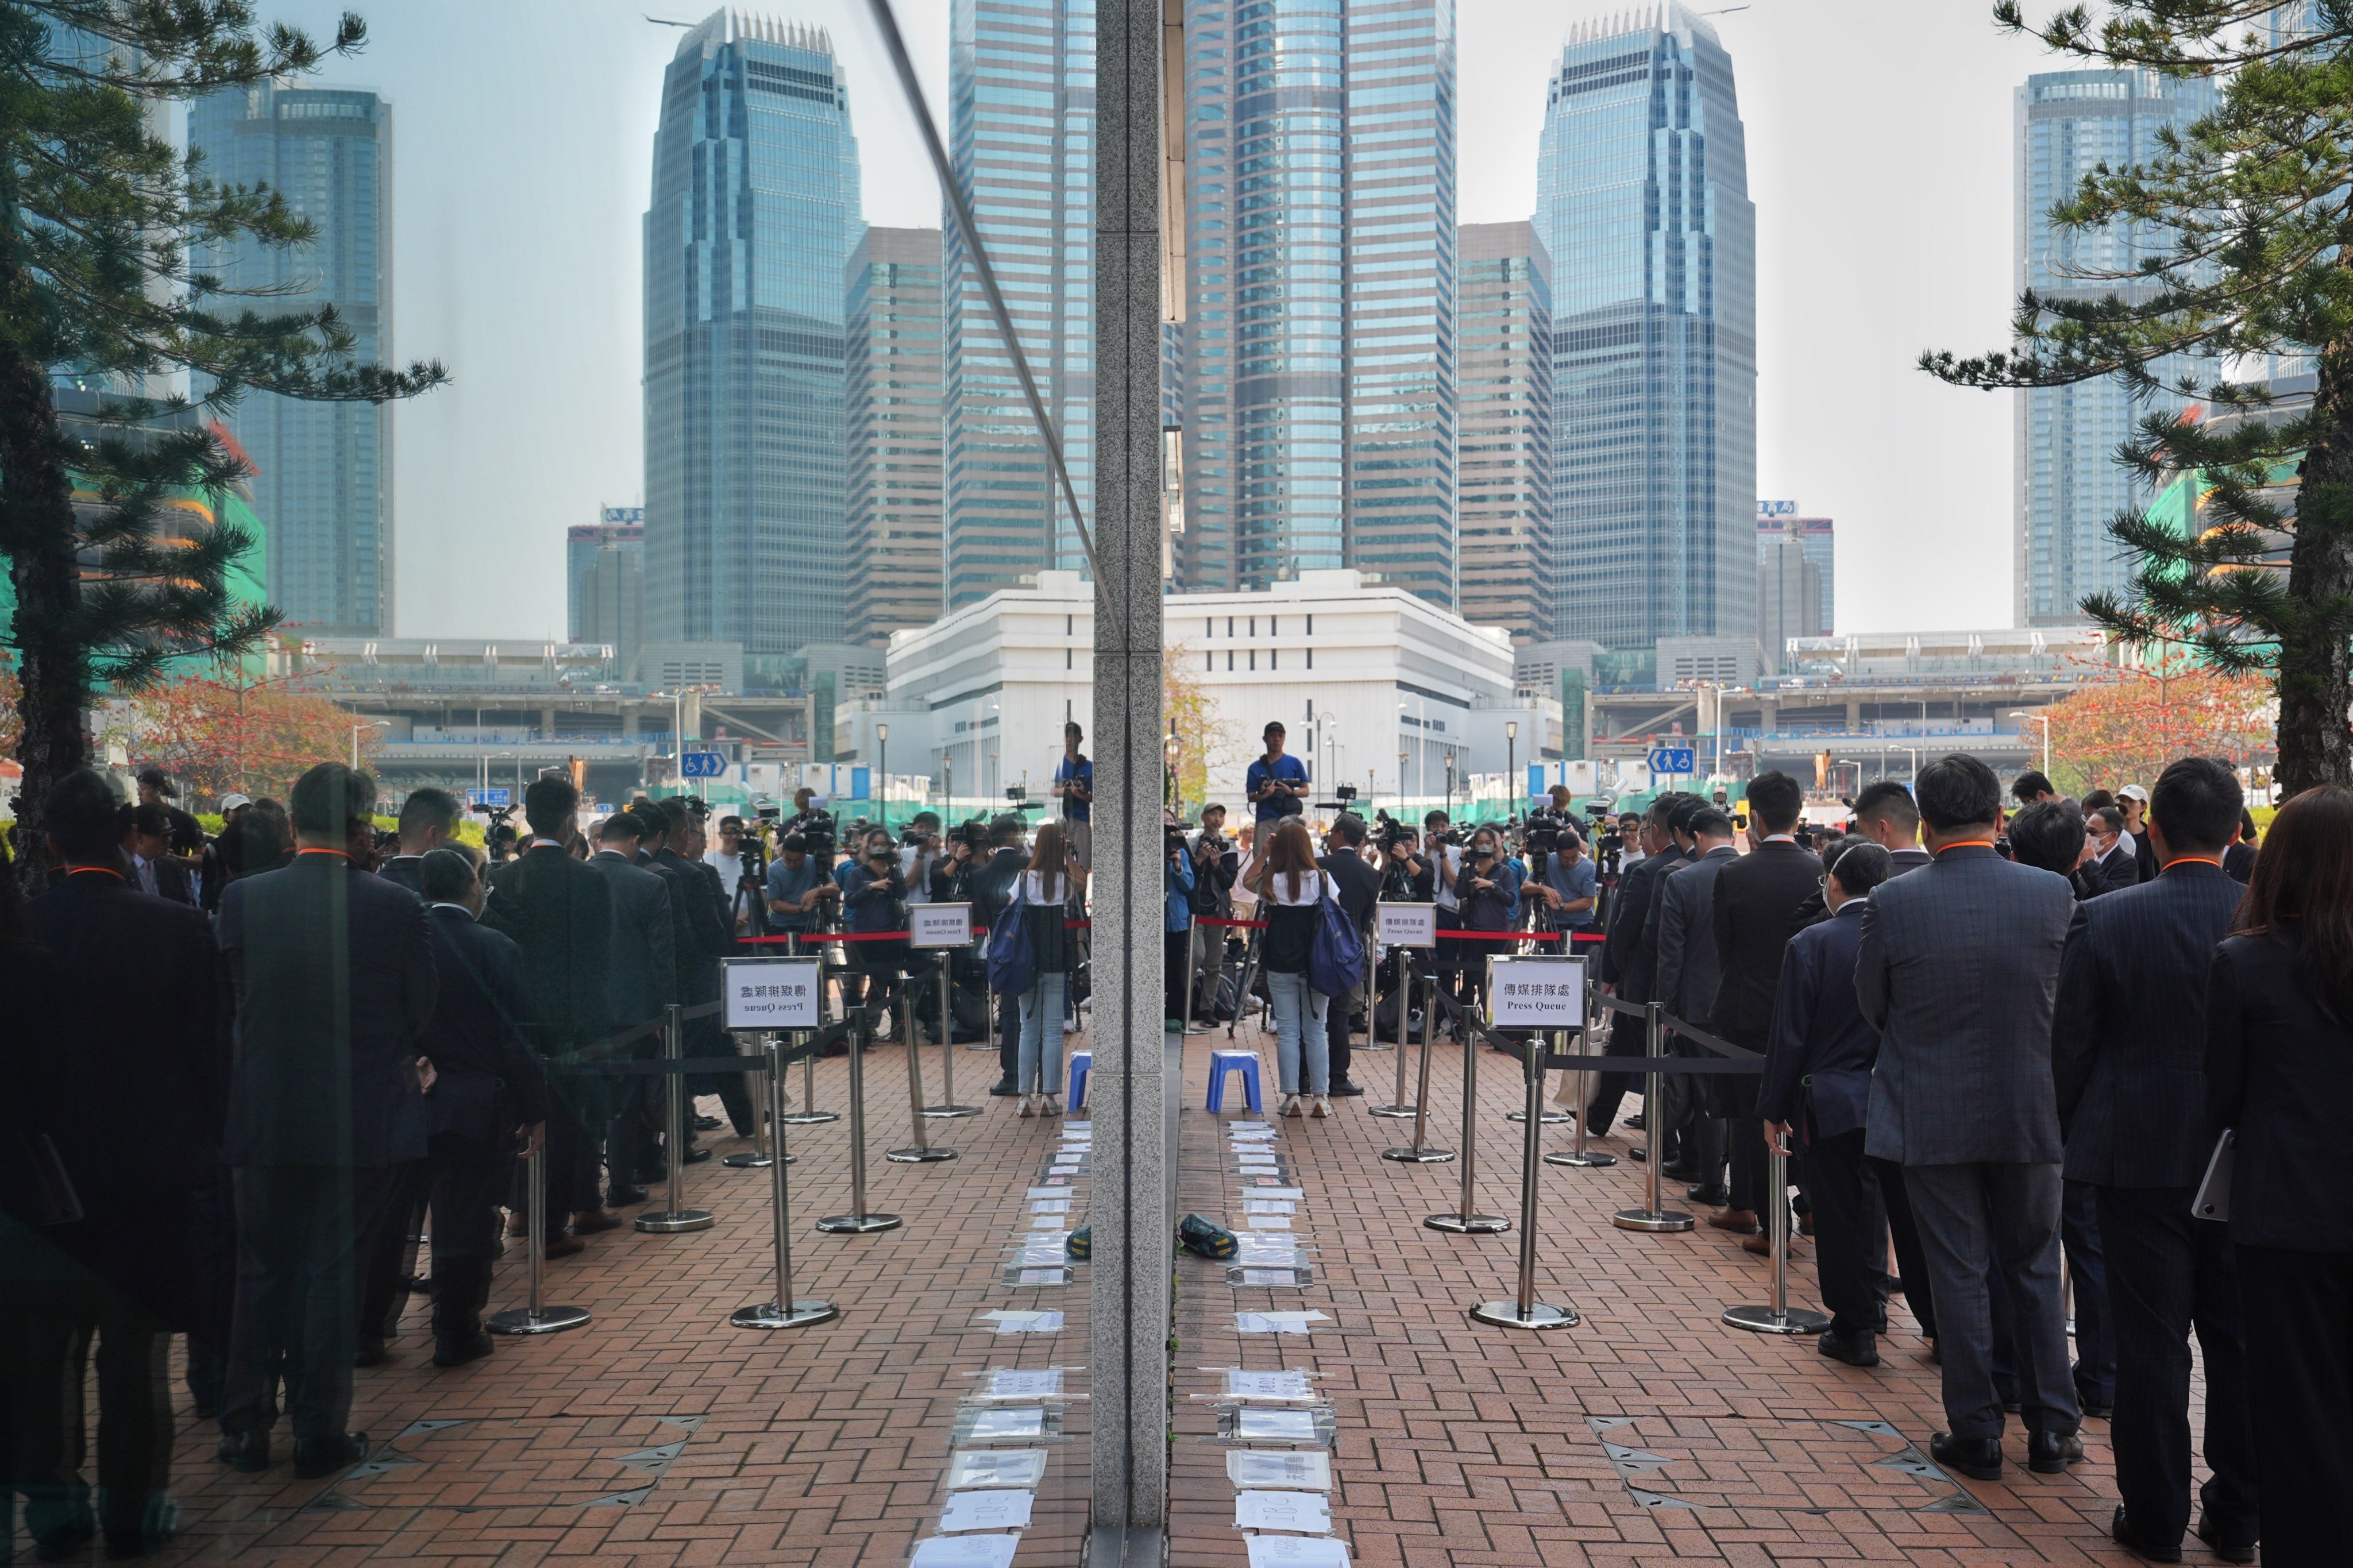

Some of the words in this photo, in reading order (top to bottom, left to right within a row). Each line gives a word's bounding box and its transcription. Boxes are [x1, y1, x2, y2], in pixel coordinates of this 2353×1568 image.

[1386, 918, 1425, 926] 傳媒排隊處
[1505, 983, 1569, 997] 傳媒排隊處
[1507, 1001, 1533, 1010] Press
[1536, 1001, 1567, 1011] Queue
[1263, 1498, 1298, 1522] IBC
